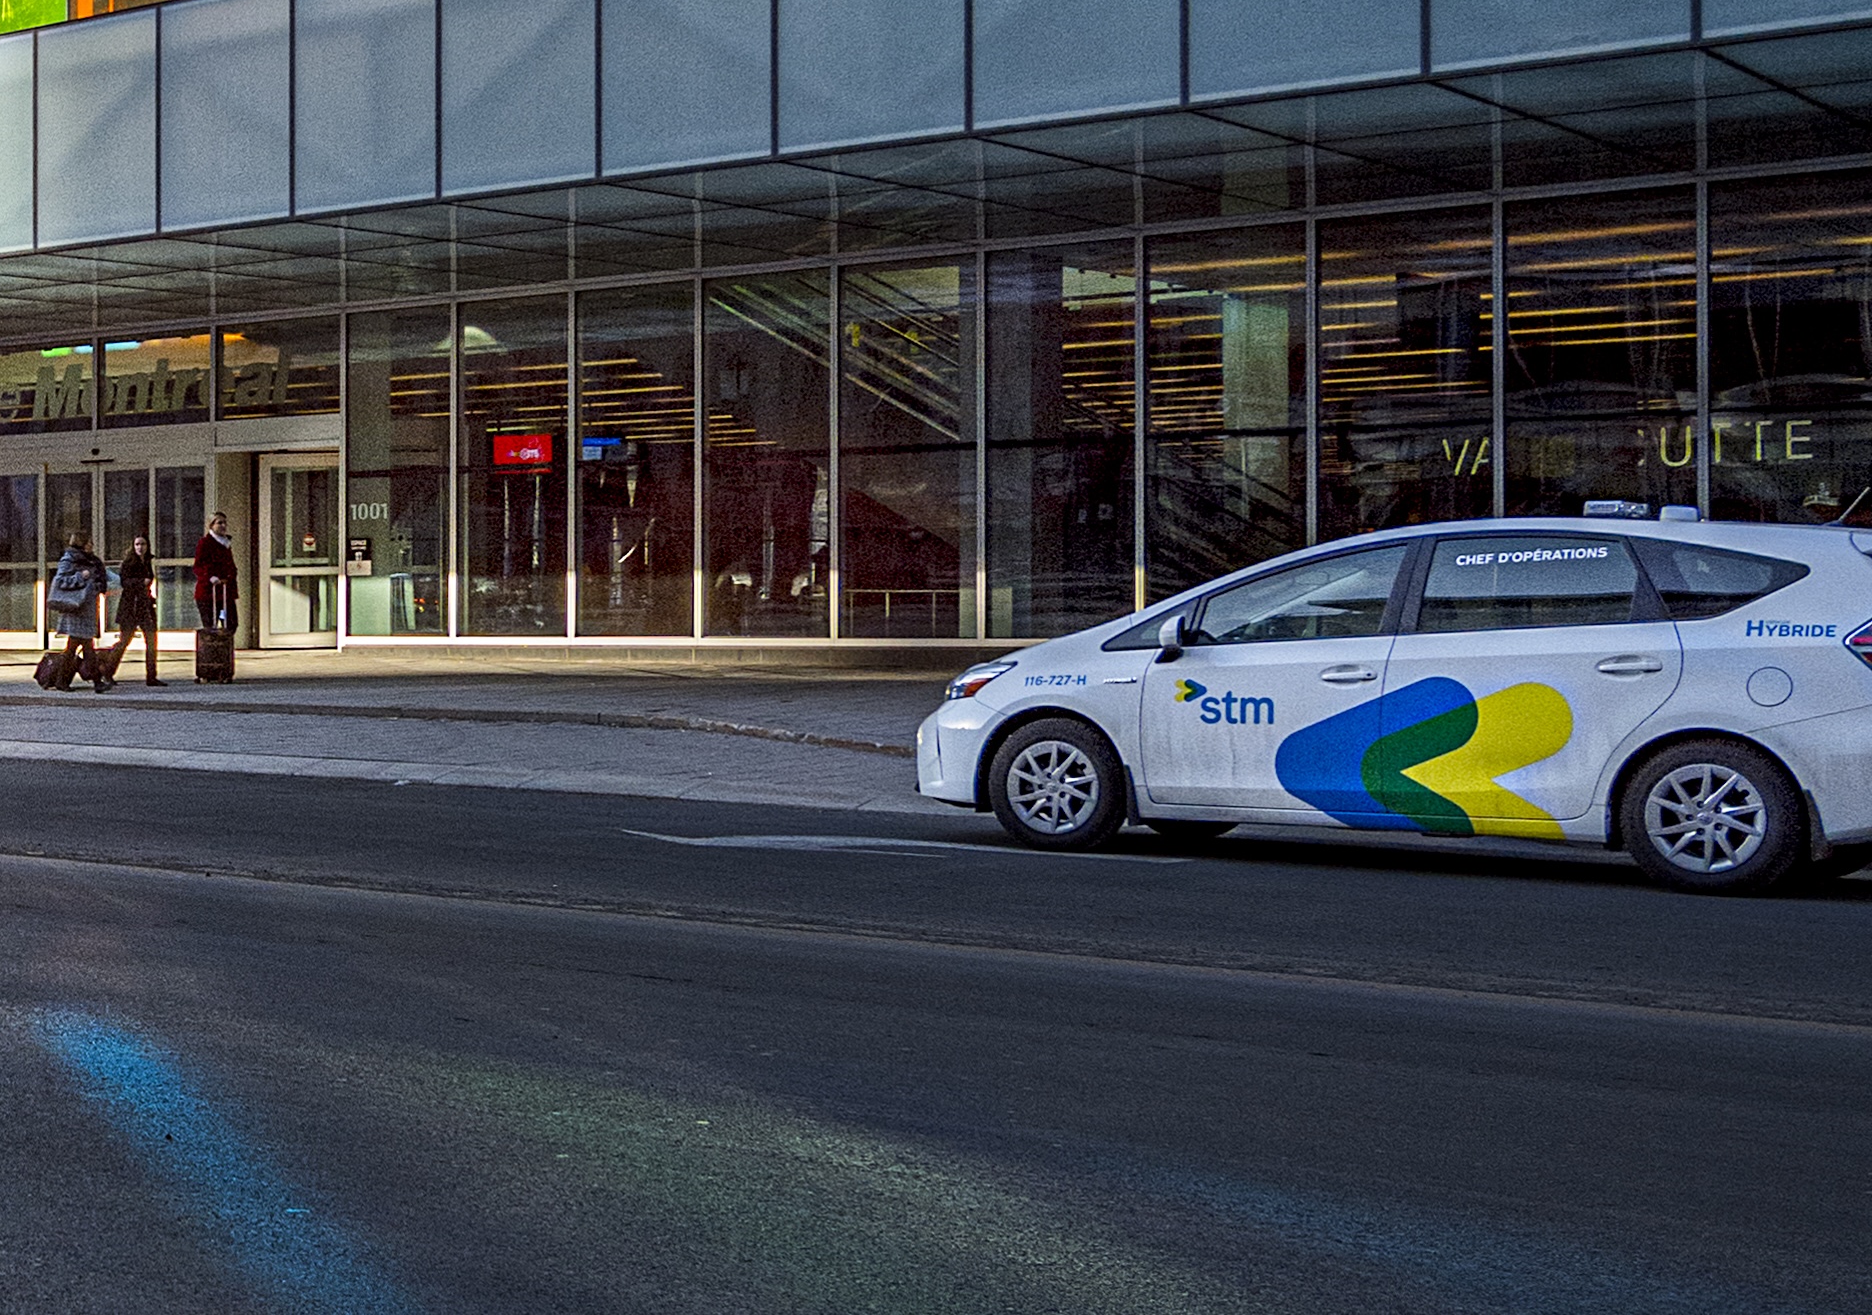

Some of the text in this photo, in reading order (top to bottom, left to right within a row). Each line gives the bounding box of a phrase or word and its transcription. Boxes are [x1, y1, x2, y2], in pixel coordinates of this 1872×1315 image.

[1442, 420, 1813, 475] VA UTTE
[350, 503, 388, 520] 1001
[1455, 546, 1609, 567] CHEF D'OPÉRATIONS
[1024, 674, 1087, 687] 116-727-H
[1200, 690, 1275, 725] stm
